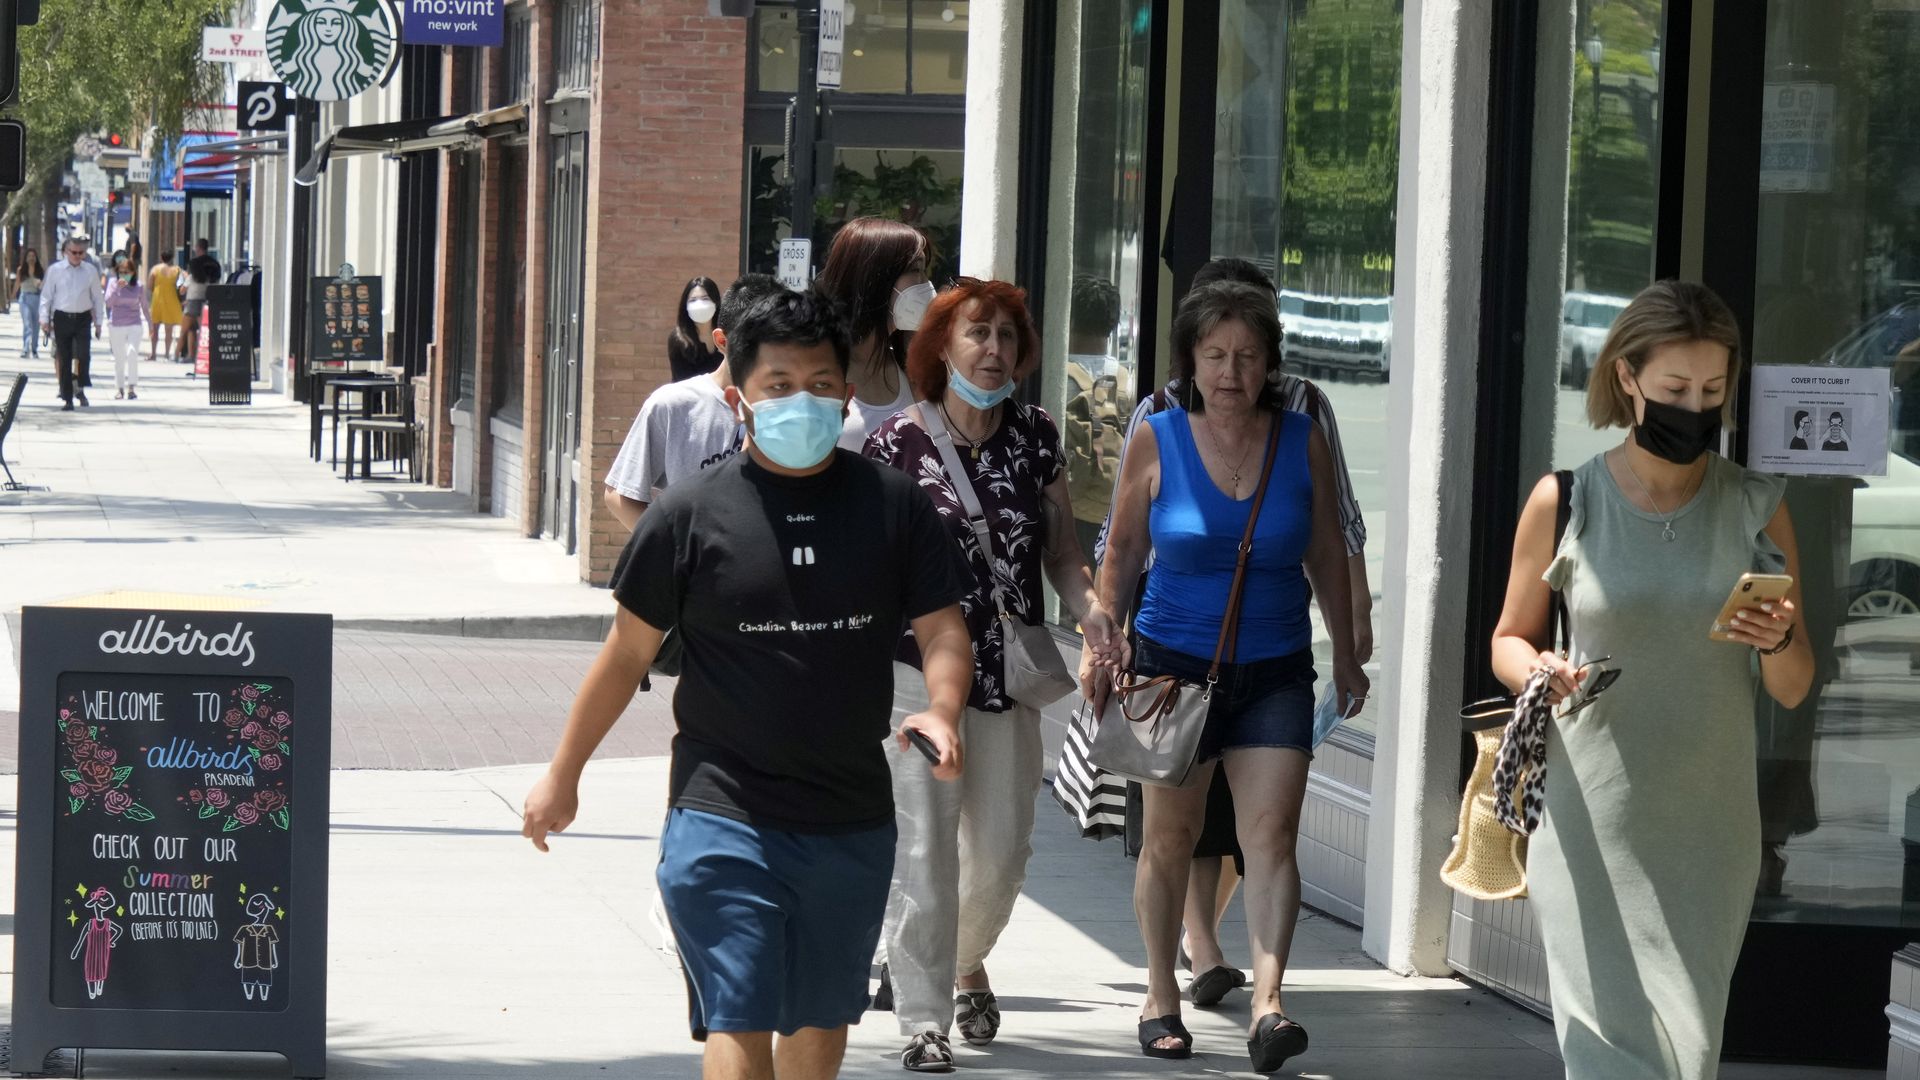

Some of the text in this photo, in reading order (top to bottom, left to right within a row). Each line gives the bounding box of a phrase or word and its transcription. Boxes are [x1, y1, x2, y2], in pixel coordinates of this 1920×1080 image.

[428, 20, 478, 33] new york
[230, 49, 264, 57] STREET
[783, 248, 805, 259] CROSS
[217, 323, 242, 331] ORDER
[739, 620, 786, 632] Canadian
[790, 620, 828, 631] Beaver
[833, 619, 844, 630] at
[99, 615, 255, 667] allbirds
[82, 690, 221, 722] WELCOME TO
[147, 737, 254, 775] allbirds
[204, 772, 255, 787] PASADENA
[93, 833, 238, 862] CHECK OUT OUR
[123, 865, 213, 889] Summer
[129, 892, 214, 918] COLLECTION
[131, 921, 164, 940] (BEFORE
[166, 919, 178, 939] IT'S
